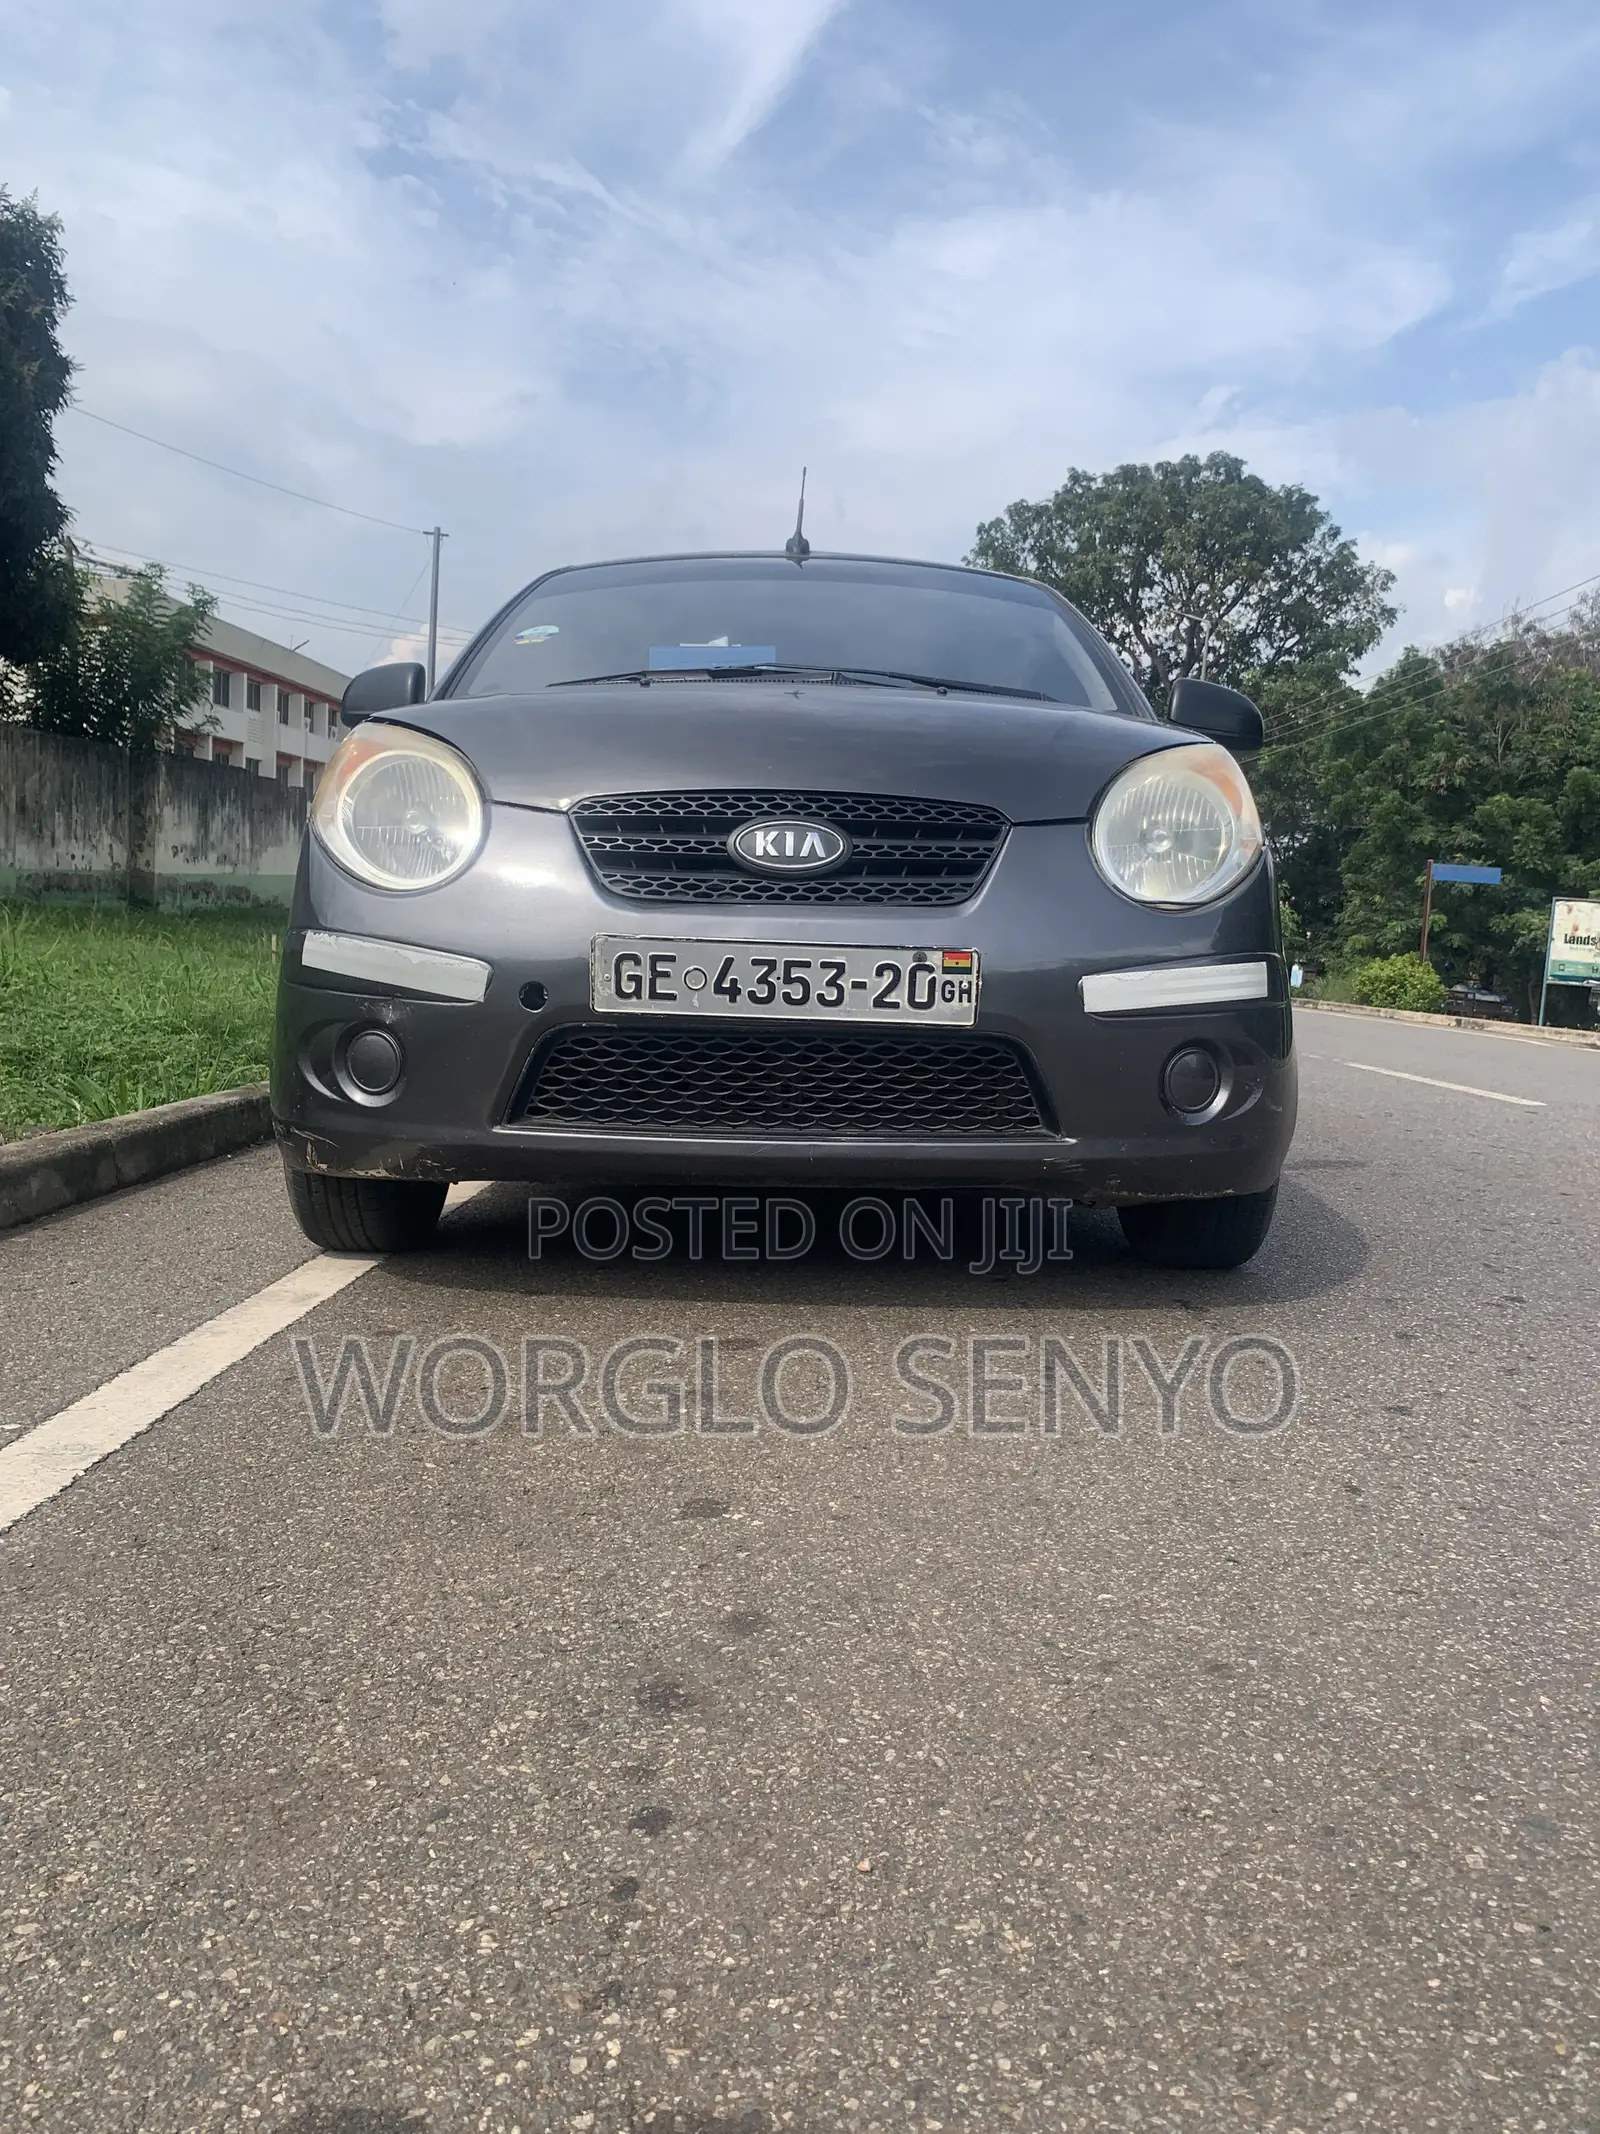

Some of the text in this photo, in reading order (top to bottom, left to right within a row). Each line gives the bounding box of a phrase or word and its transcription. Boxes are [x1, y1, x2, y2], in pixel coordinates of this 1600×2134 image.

[754, 830, 826, 858] KIA
[613, 952, 937, 1010] GE 4353-20
[941, 980, 972, 1003] GH
